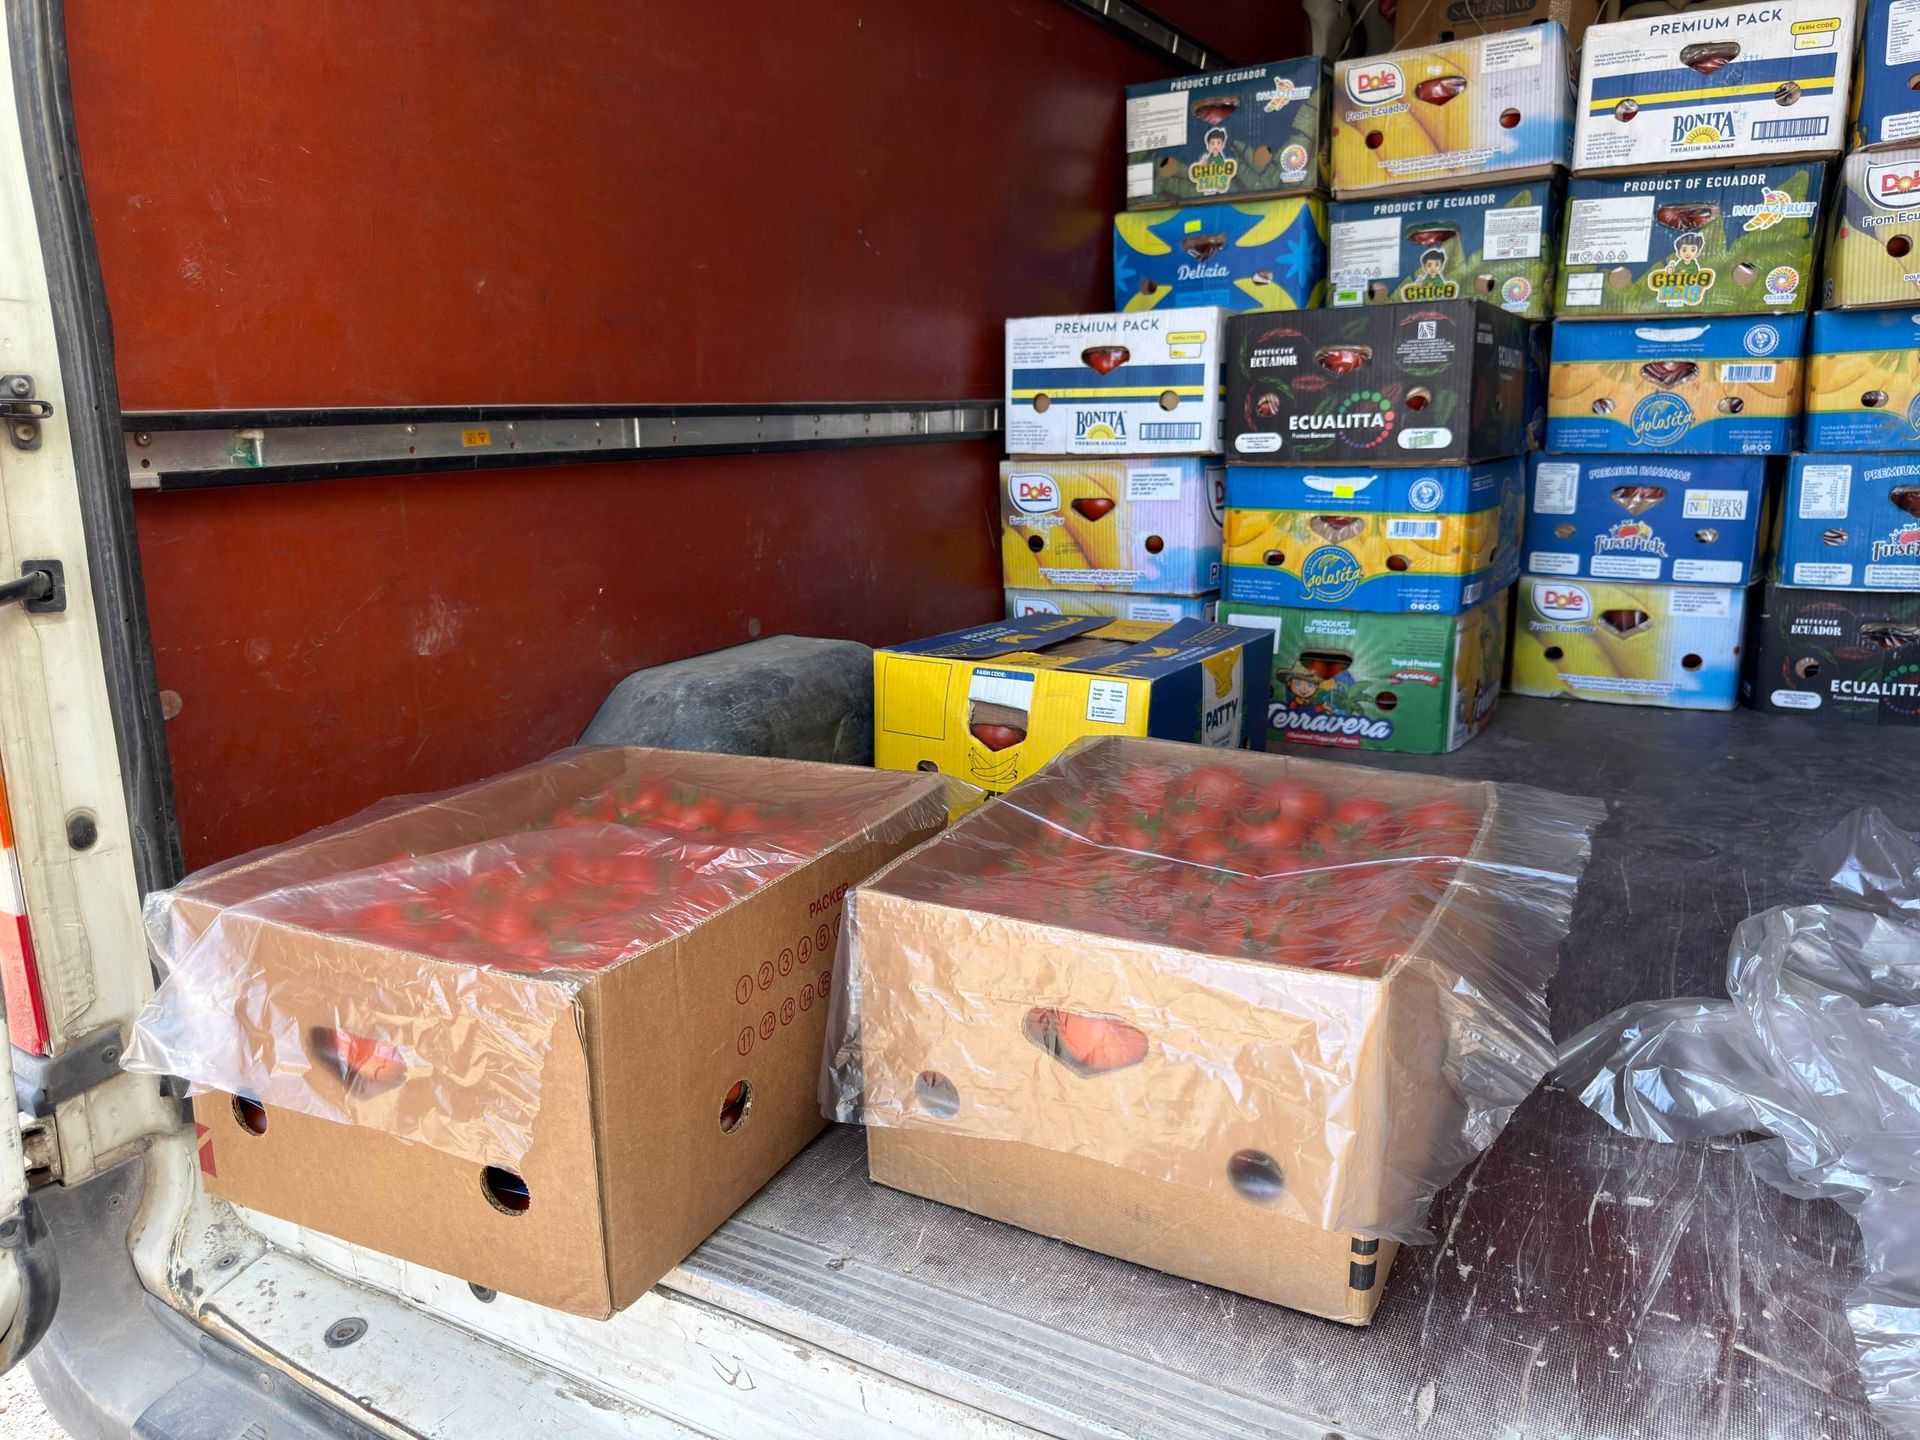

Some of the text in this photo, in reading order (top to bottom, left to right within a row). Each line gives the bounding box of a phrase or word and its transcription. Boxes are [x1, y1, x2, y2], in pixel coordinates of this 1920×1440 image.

[1650, 8, 1783, 36] PREMIUM PACK
[1170, 68, 1267, 91] PRODUCT OF ECUADOR
[1358, 70, 1396, 90] Dole
[1346, 104, 1409, 121] From Ecuador
[1671, 111, 1736, 143] BONITA
[1671, 143, 1735, 153] PREMIUM BANANAS
[1191, 161, 1236, 178] CHICO
[1623, 174, 1766, 192] PRODUCT OF ECUADOR
[1881, 170, 1920, 192] Dol
[1373, 194, 1496, 216] PRODUCT OF ECUADOR
[1863, 215, 1894, 227] From
[1177, 263, 1230, 281] Delizia
[1652, 272, 1711, 287] CHICO
[1404, 284, 1457, 300] CHICO
[1054, 319, 1160, 334] PREMIUM PACK
[1250, 355, 1298, 368] ECUADOR
[1075, 410, 1127, 436] BONITA
[1289, 412, 1385, 431] ECUALITTA
[1588, 466, 1692, 482] PREMIUM BANANAS
[1020, 482, 1052, 499] Dole
[1713, 499, 1744, 507] NESTA
[1711, 506, 1743, 518] BAN
[1544, 590, 1584, 607] Dole
[1304, 626, 1356, 636] OF ECUADOR
[1312, 619, 1350, 628] PRODUCT
[1529, 622, 1595, 634] From Ecuador
[1790, 624, 1842, 636] ECUADOR
[1391, 658, 1441, 668] Tropical Premium
[1206, 698, 1239, 733] PATTY
[1267, 703, 1391, 739] Terravera
